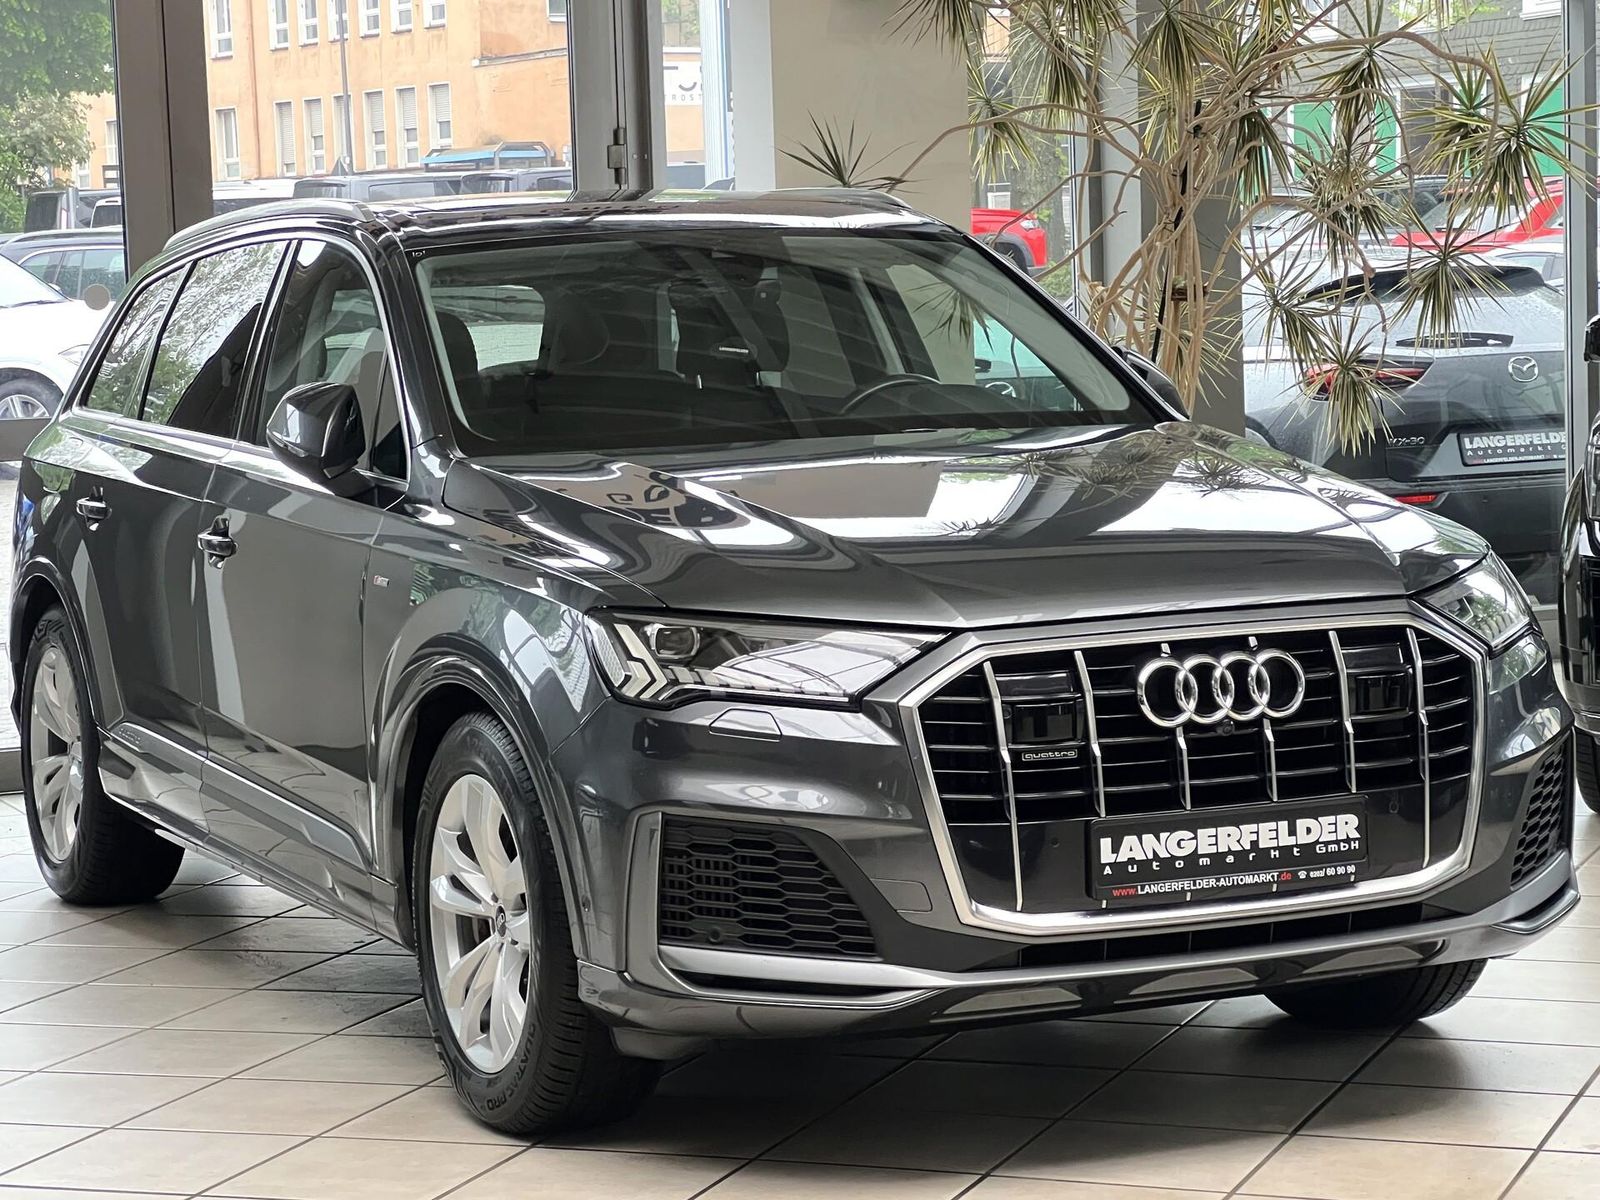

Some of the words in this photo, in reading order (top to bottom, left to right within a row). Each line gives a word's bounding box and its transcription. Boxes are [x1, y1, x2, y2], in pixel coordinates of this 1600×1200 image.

[1025, 751, 1076, 760] quattro
[1100, 813, 1361, 864] LANGERFELDER
[1316, 840, 1360, 854] GmbH
[1112, 872, 1292, 897] www.LANGERFELDER-AUTOMARKT.de
[1337, 865, 1346, 875] 90
[1347, 864, 1356, 874] 90
